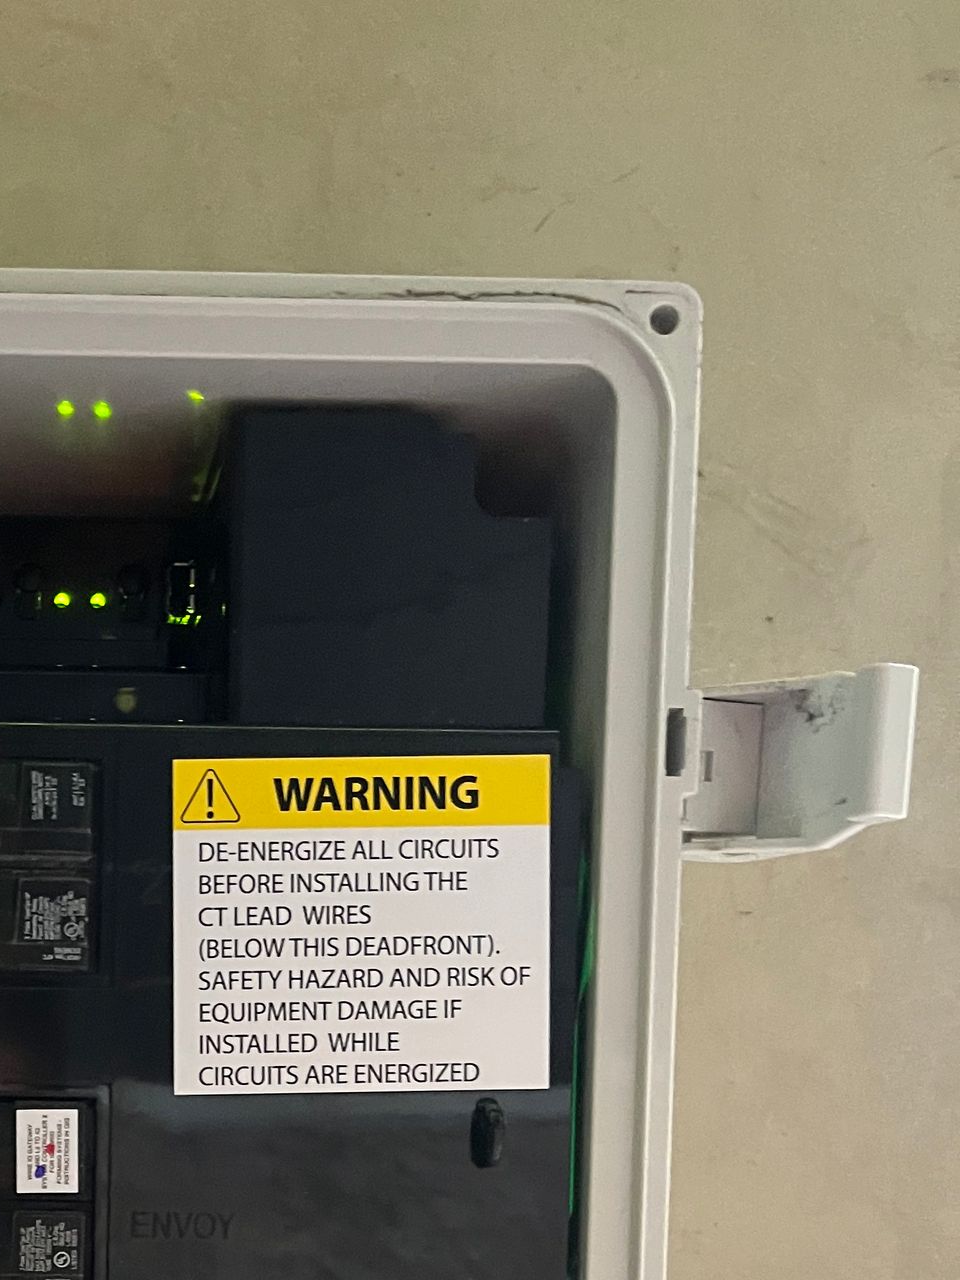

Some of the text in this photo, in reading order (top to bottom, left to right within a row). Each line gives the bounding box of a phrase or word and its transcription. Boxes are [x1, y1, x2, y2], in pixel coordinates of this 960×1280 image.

[274, 776, 478, 811] WARNING
[199, 839, 498, 862] DE-ENERGIZE ALL CIRCUITS
[199, 872, 467, 894] BEFORE INSTALLING THE
[199, 905, 371, 926] CT LEAD WIRES
[200, 935, 499, 961] (BELOW THIS DEADFRONT).
[199, 967, 530, 990] SAFETY HAZARD AND RISK OF
[200, 1000, 462, 1024] EQUIPMENT DAMAGE IF
[200, 1032, 400, 1054] INSTALLED WHILE
[199, 1063, 479, 1085] CIRCUITS ARE ENERGIZED
[130, 1211, 234, 1240] ENVOY
